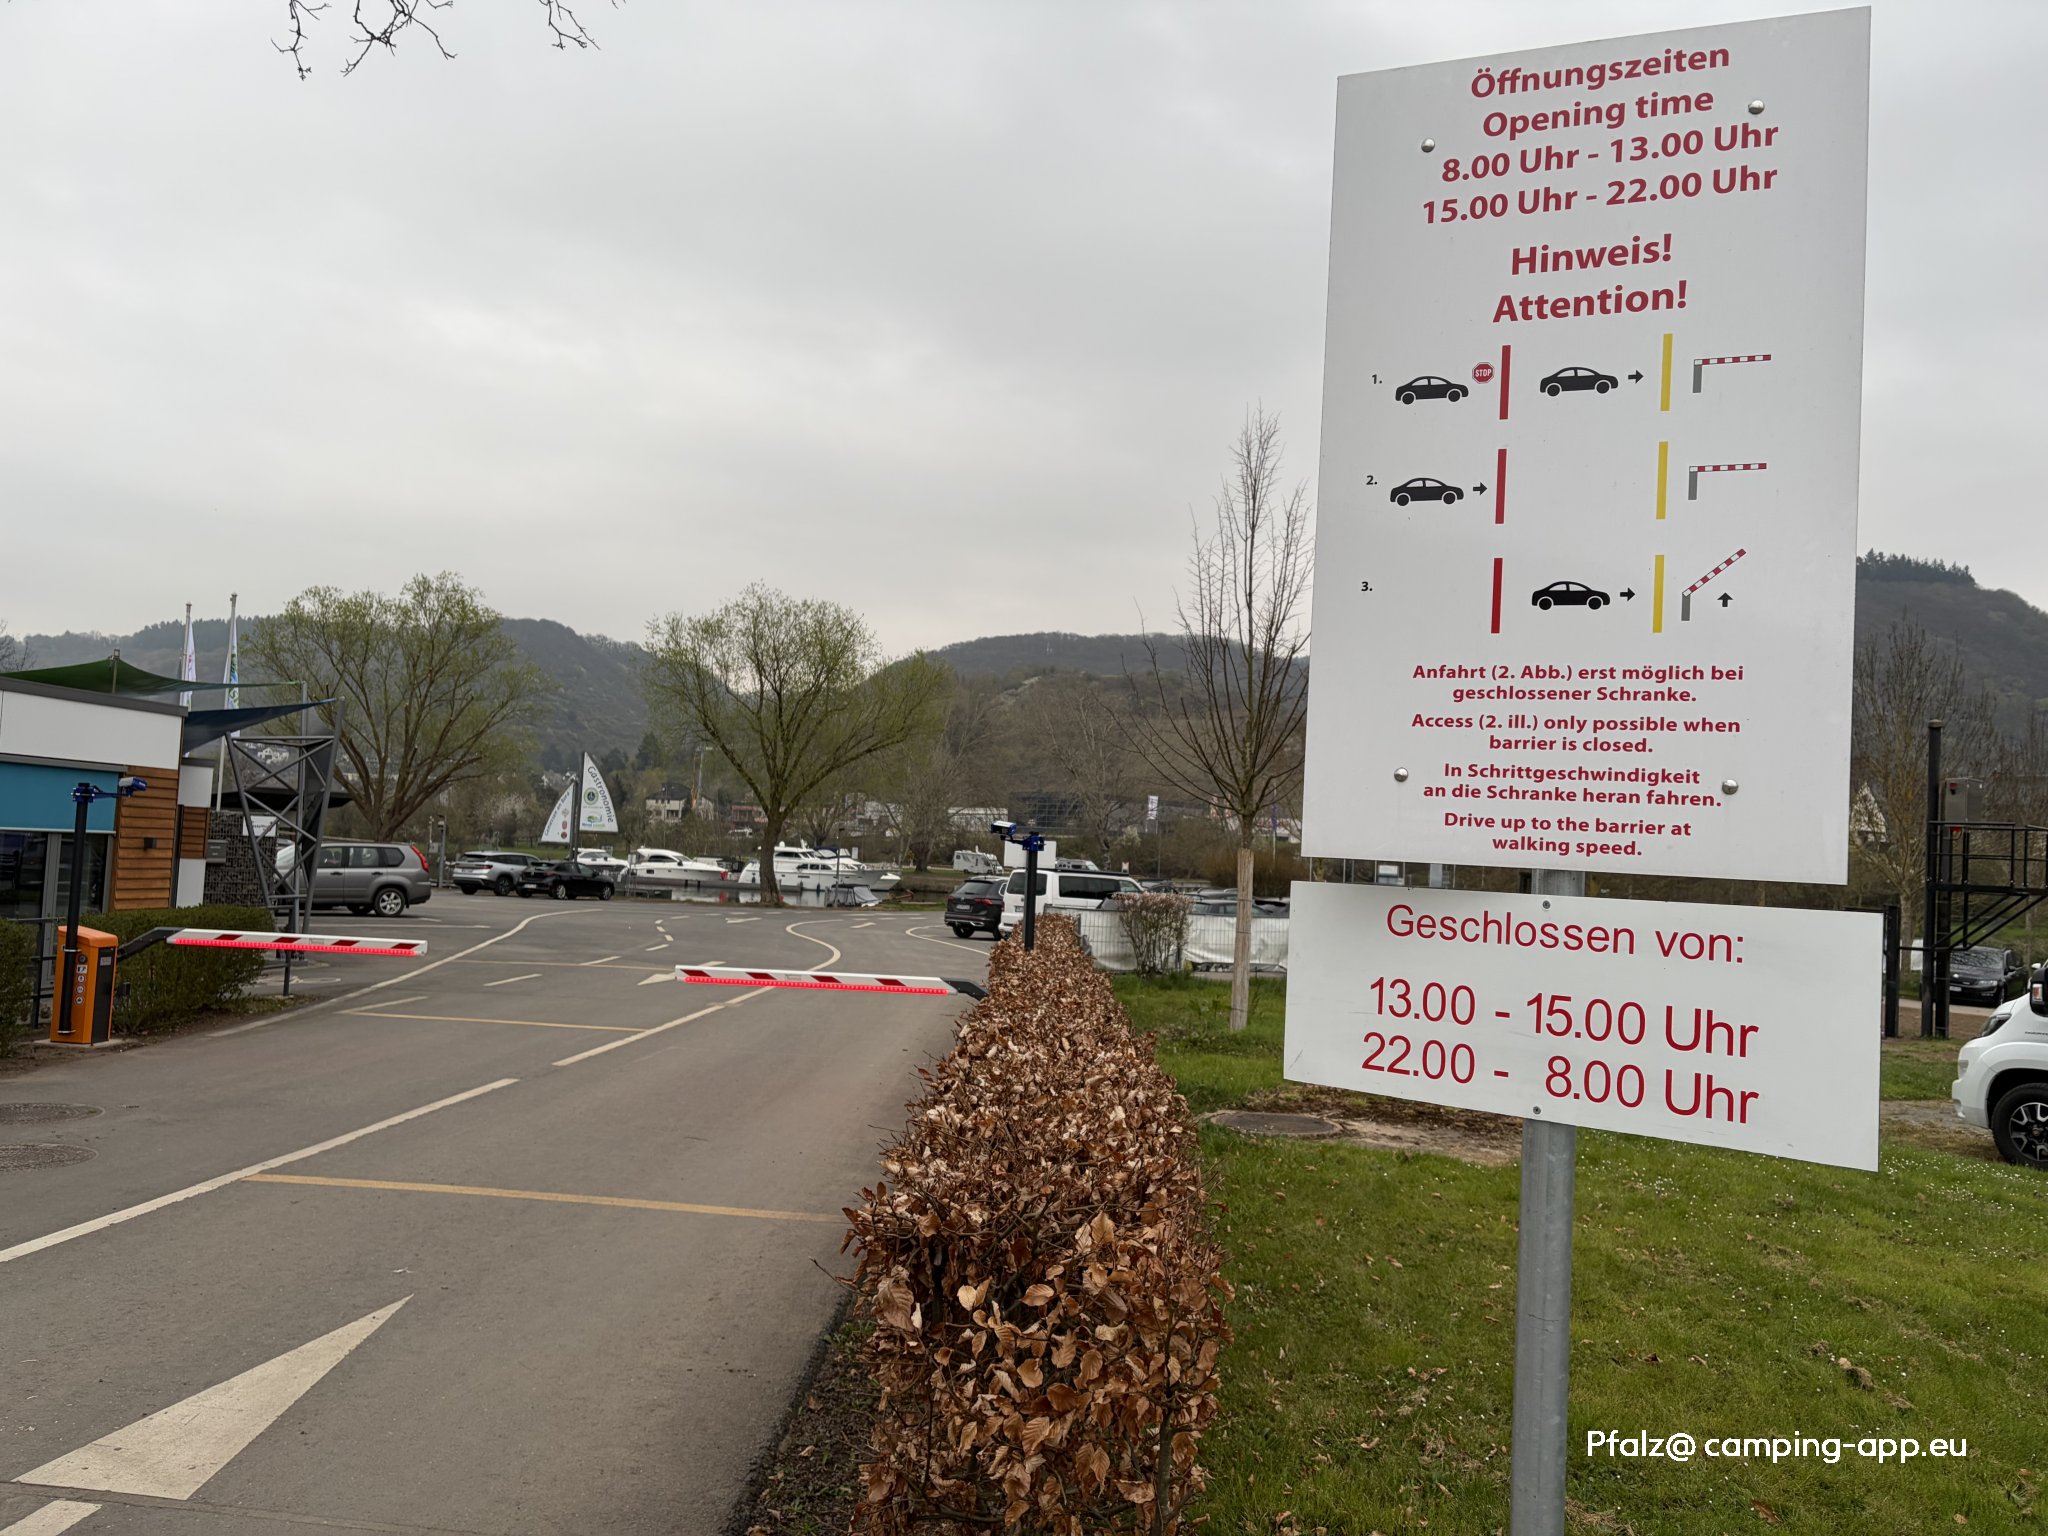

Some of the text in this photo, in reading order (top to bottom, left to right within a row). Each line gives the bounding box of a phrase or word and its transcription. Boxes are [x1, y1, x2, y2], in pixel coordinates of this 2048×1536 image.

[1471, 48, 1730, 96] Öffnungszeiten
[1484, 92, 1713, 141] Opening time
[1442, 153, 1510, 183] 8.00
[1520, 145, 1578, 174] Uhr
[1611, 131, 1703, 163] 13.00
[1714, 123, 1779, 152] Uhr
[1423, 194, 1508, 224] 15.00
[1518, 187, 1578, 215] Uhr
[1606, 172, 1702, 206] 22.00
[1712, 165, 1778, 194] Uhr
[1511, 233, 1673, 276] Hinweis!
[1492, 280, 1688, 323] Attention!
[1371, 374, 1383, 385] 1.
[1475, 368, 1492, 378] STOP
[1366, 475, 1378, 486] 2.
[1361, 581, 1373, 592] 3.
[1412, 664, 1744, 684] Anfahrt (2. Abb.) erst möglich bei
[1452, 685, 1697, 703] geschlossener Schranke.
[1411, 713, 1741, 736] Access (2. ill.) only possible when
[1489, 735, 1654, 753] barrier is closed.
[1444, 763, 1701, 787] In Schrittgeschwindigkeit
[587, 766, 615, 823] Gastronomie
[1423, 784, 1722, 808] an die Schranke heran fahren.
[1443, 812, 1692, 838] Drive up to the barrier at
[1492, 836, 1643, 859] walking speed.
[1386, 904, 1745, 964] Geschlossen von:
[1370, 976, 1477, 1026] 13.00
[1526, 993, 1647, 1046] 15.00
[1664, 1004, 1760, 1058] Uhr
[1361, 1031, 1476, 1085] 22.00
[1544, 1055, 1646, 1109] 8.00
[1664, 1069, 1760, 1125] Uhr
